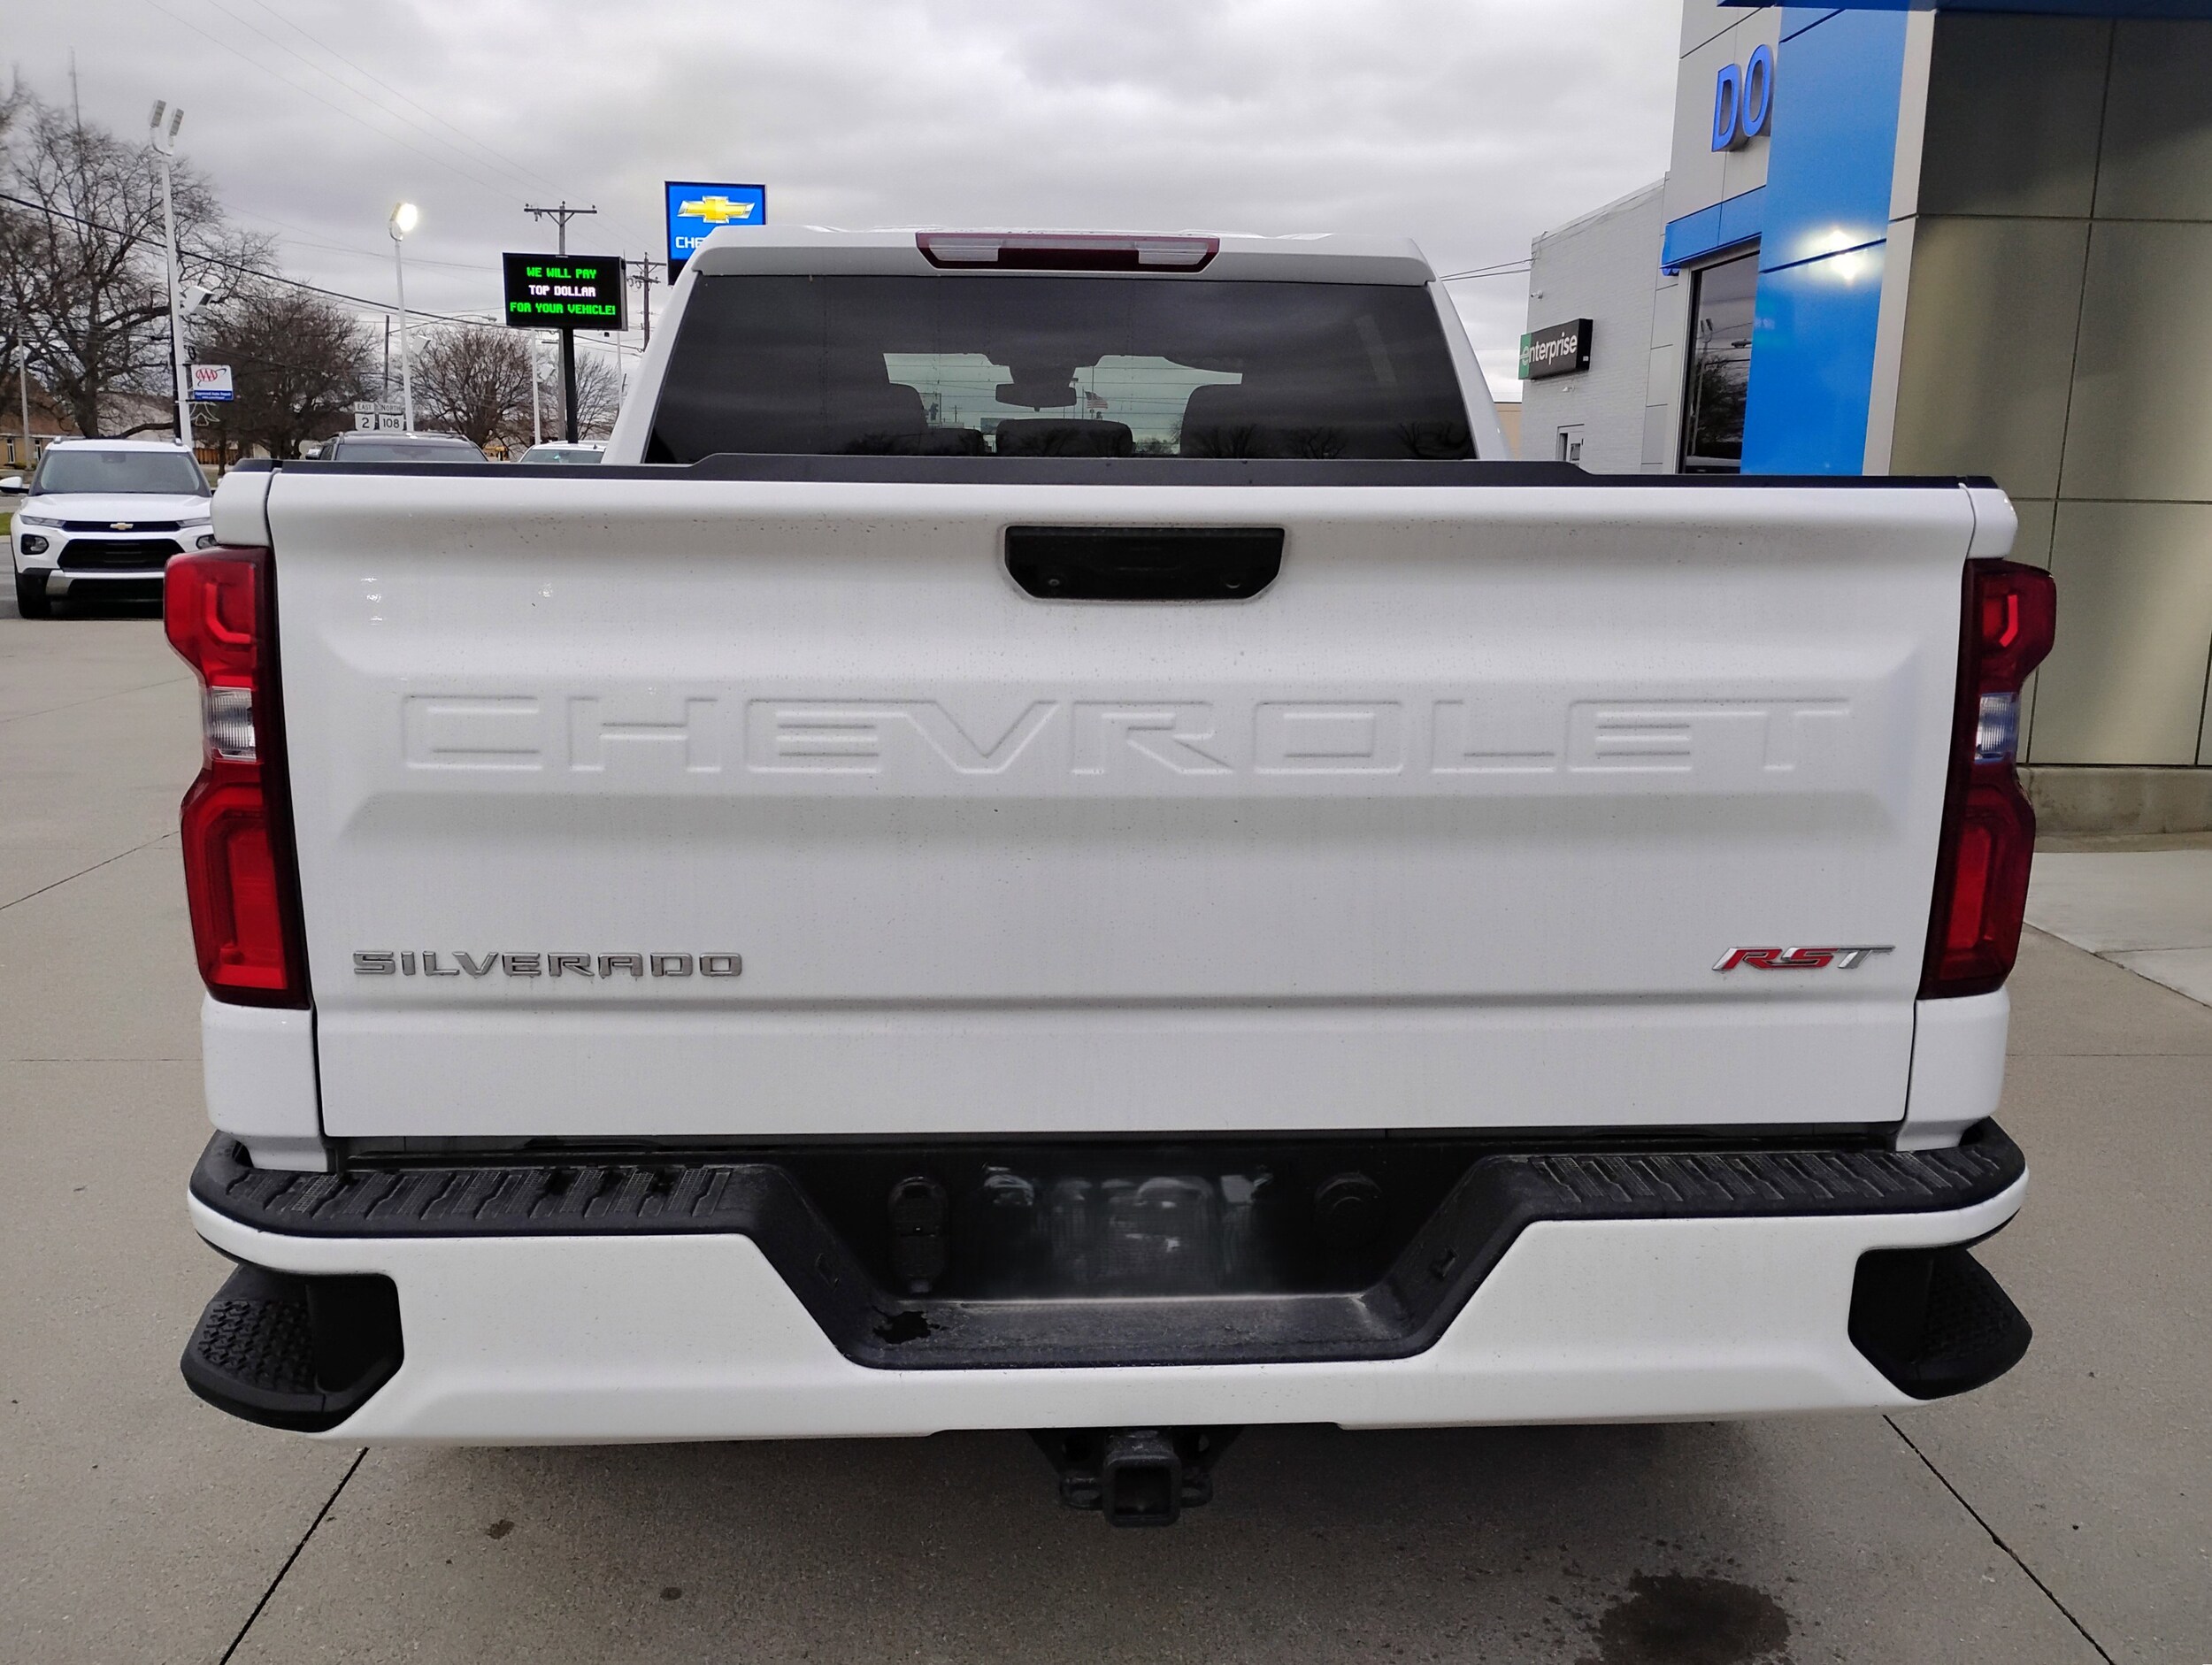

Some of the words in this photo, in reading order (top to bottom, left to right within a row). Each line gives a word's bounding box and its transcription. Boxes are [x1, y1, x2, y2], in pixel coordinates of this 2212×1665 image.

[1711, 44, 1773, 152] DO
[526, 267, 541, 277] WE
[547, 268, 571, 278] WILL
[575, 269, 596, 279] PAY
[528, 285, 549, 295] TOP
[554, 286, 595, 296] DOLLAR
[510, 303, 531, 312] FOR
[535, 303, 564, 313] YOUR
[567, 304, 616, 315] VEHICLE!
[1520, 332, 1578, 365] enterprise
[361, 417, 370, 428] 2
[382, 418, 400, 428] 108
[402, 694, 1852, 773] CHEVROLET
[353, 950, 742, 978] SILVERADO
[1712, 945, 1896, 971] RST
